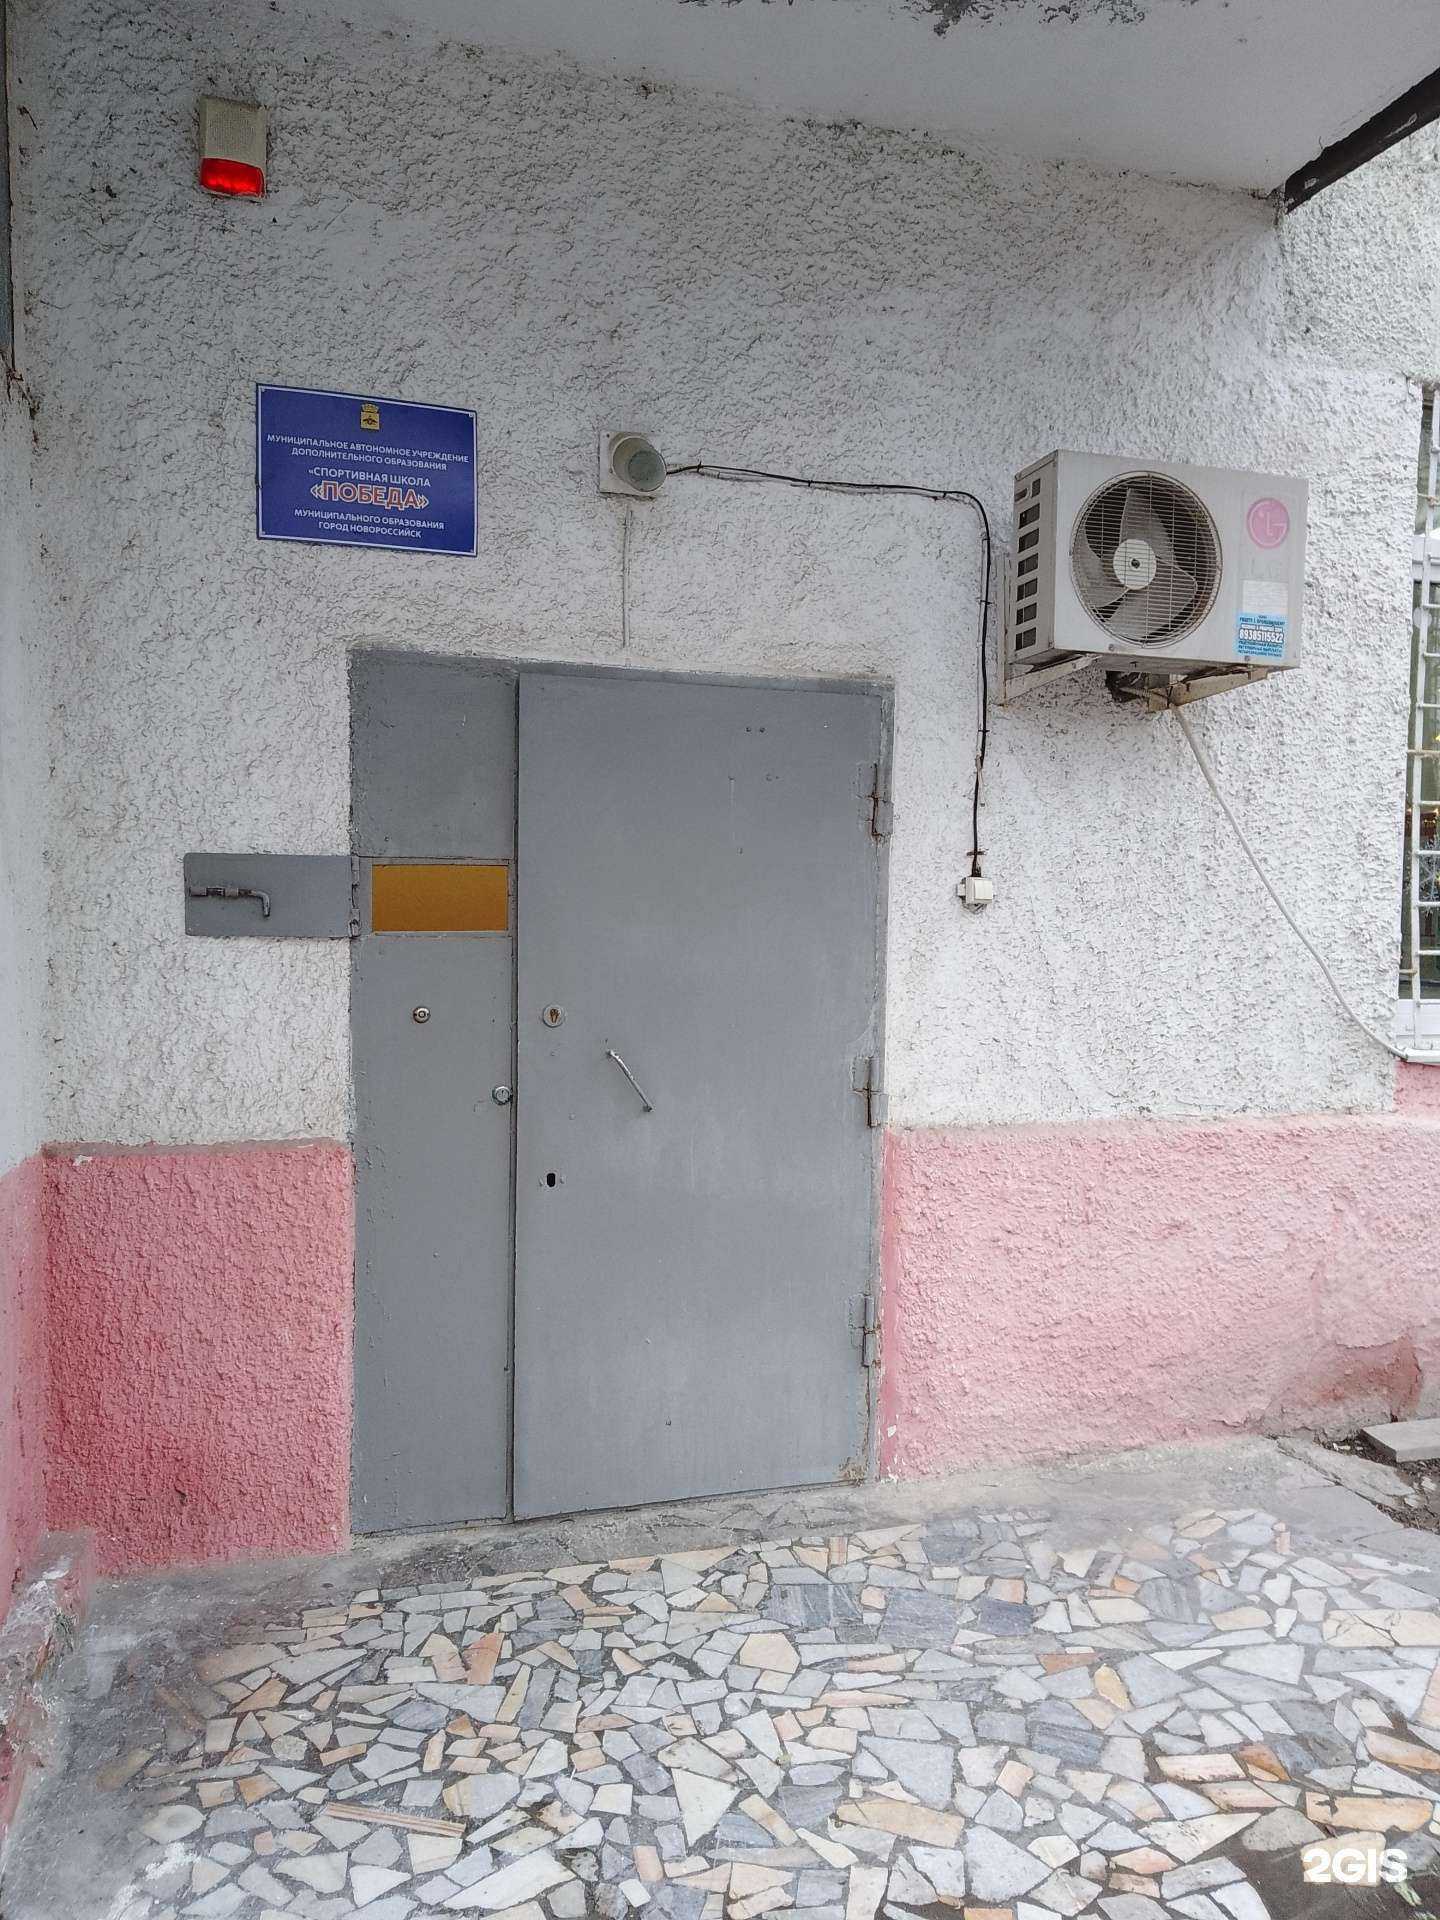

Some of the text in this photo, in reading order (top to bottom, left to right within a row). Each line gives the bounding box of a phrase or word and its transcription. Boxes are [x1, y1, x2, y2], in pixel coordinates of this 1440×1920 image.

[267, 434, 469, 463] МУНИЦИПАЛЬНОЕ АВТОНОМНОЕ УЧРЕЖДЕНИЕ
[292, 447, 447, 471] ДОПОЛНИТЕЛЬНОГО ОБРАЗОВАНИЯ
[389, 475, 431, 487] ШКОЛА
[310, 480, 429, 511] «ПОБЕДА»
[294, 508, 445, 530] МУНИЦИПАЛЬНОГО ОБРАЗОВАНИЯ
[318, 521, 422, 538] ГОРОД НОВОРОССИЙСК
